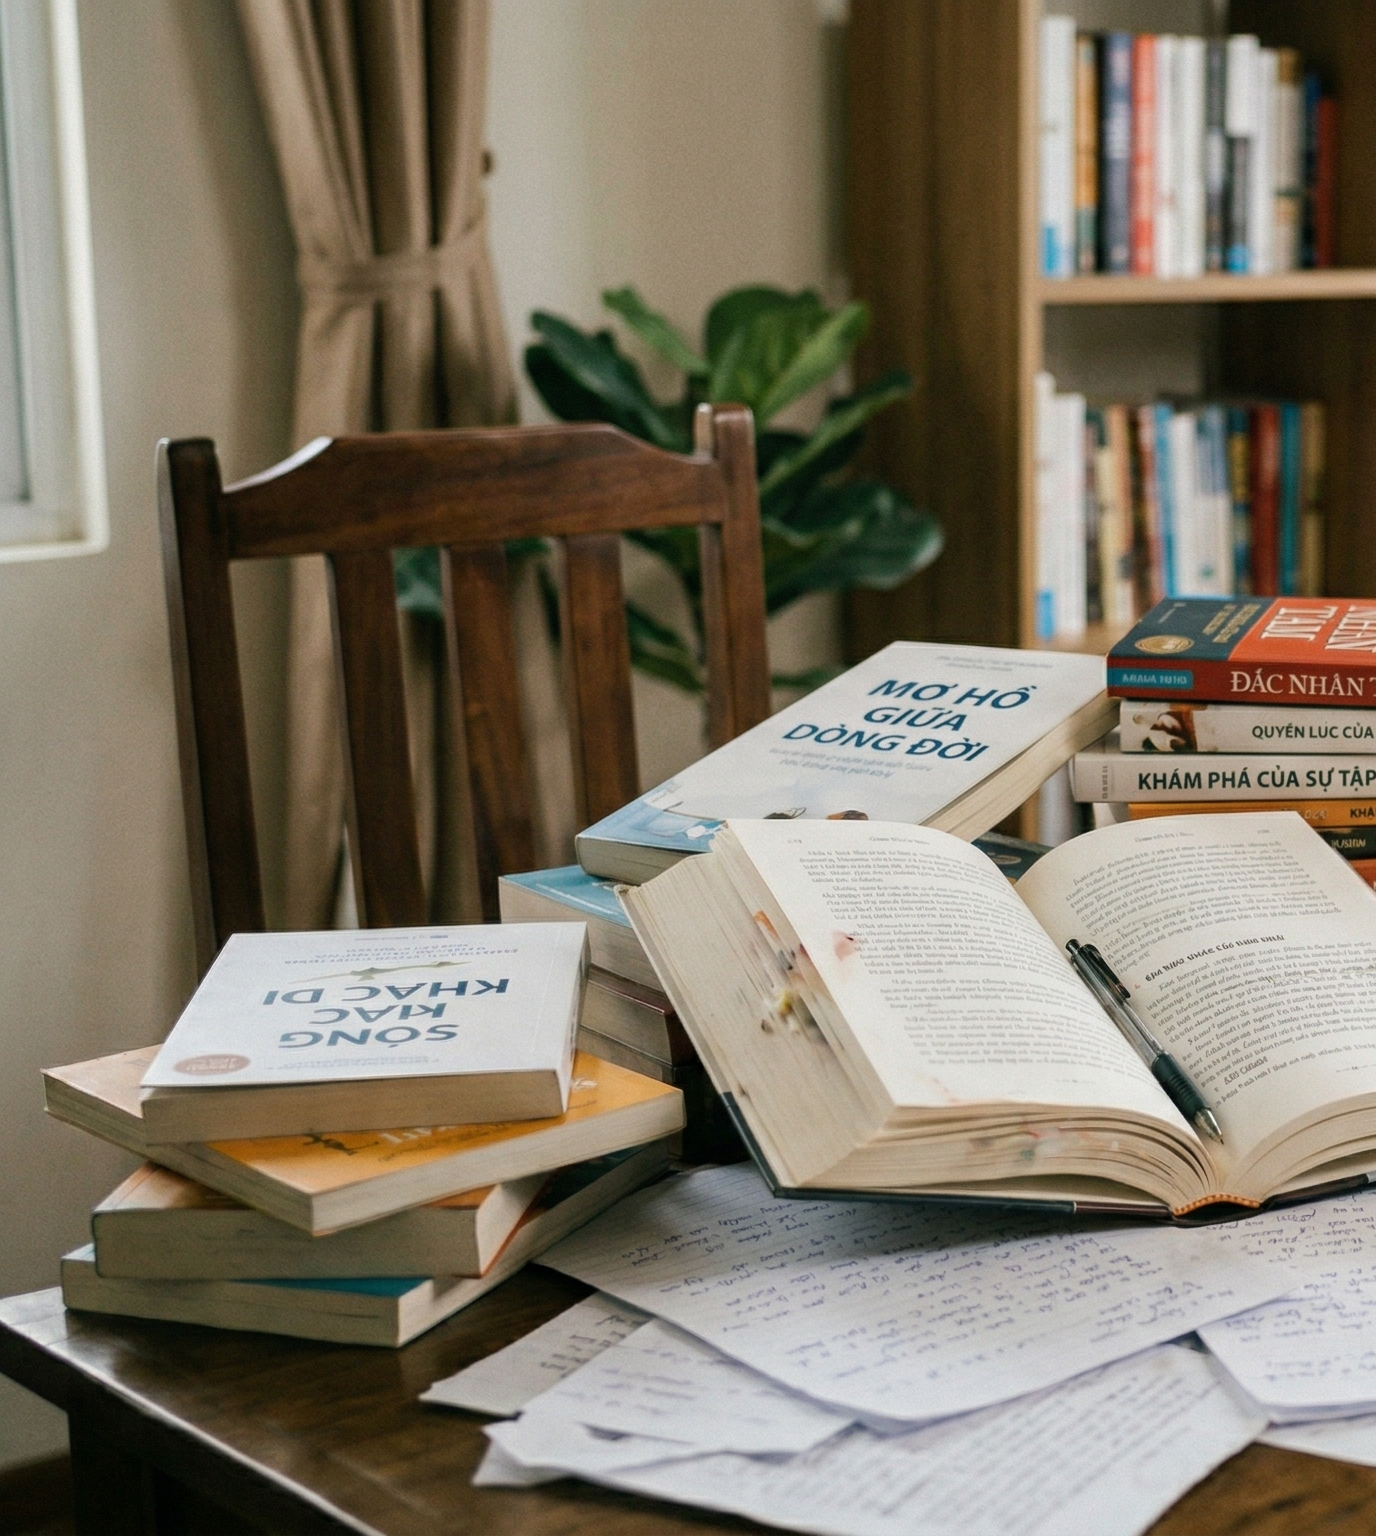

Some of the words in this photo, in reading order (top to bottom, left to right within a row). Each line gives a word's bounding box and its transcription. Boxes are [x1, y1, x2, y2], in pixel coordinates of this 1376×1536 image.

[868, 679, 959, 701] MƠ
[953, 685, 1037, 709] HỒ
[1289, 673, 1364, 697] NHÂN
[863, 707, 967, 731] GIỮA
[1342, 721, 1374, 739] CỦA
[782, 722, 906, 752] DÒNG
[905, 737, 989, 761] ĐỜI
[1138, 768, 1202, 790] KHÁM
[1208, 767, 1251, 789] PHÁ
[1257, 765, 1300, 789] CỦA
[1306, 767, 1334, 792] SỰ
[1339, 766, 1376, 792] TẬP
[262, 988, 325, 1006] DI
[278, 1024, 460, 1049] SÓNG
